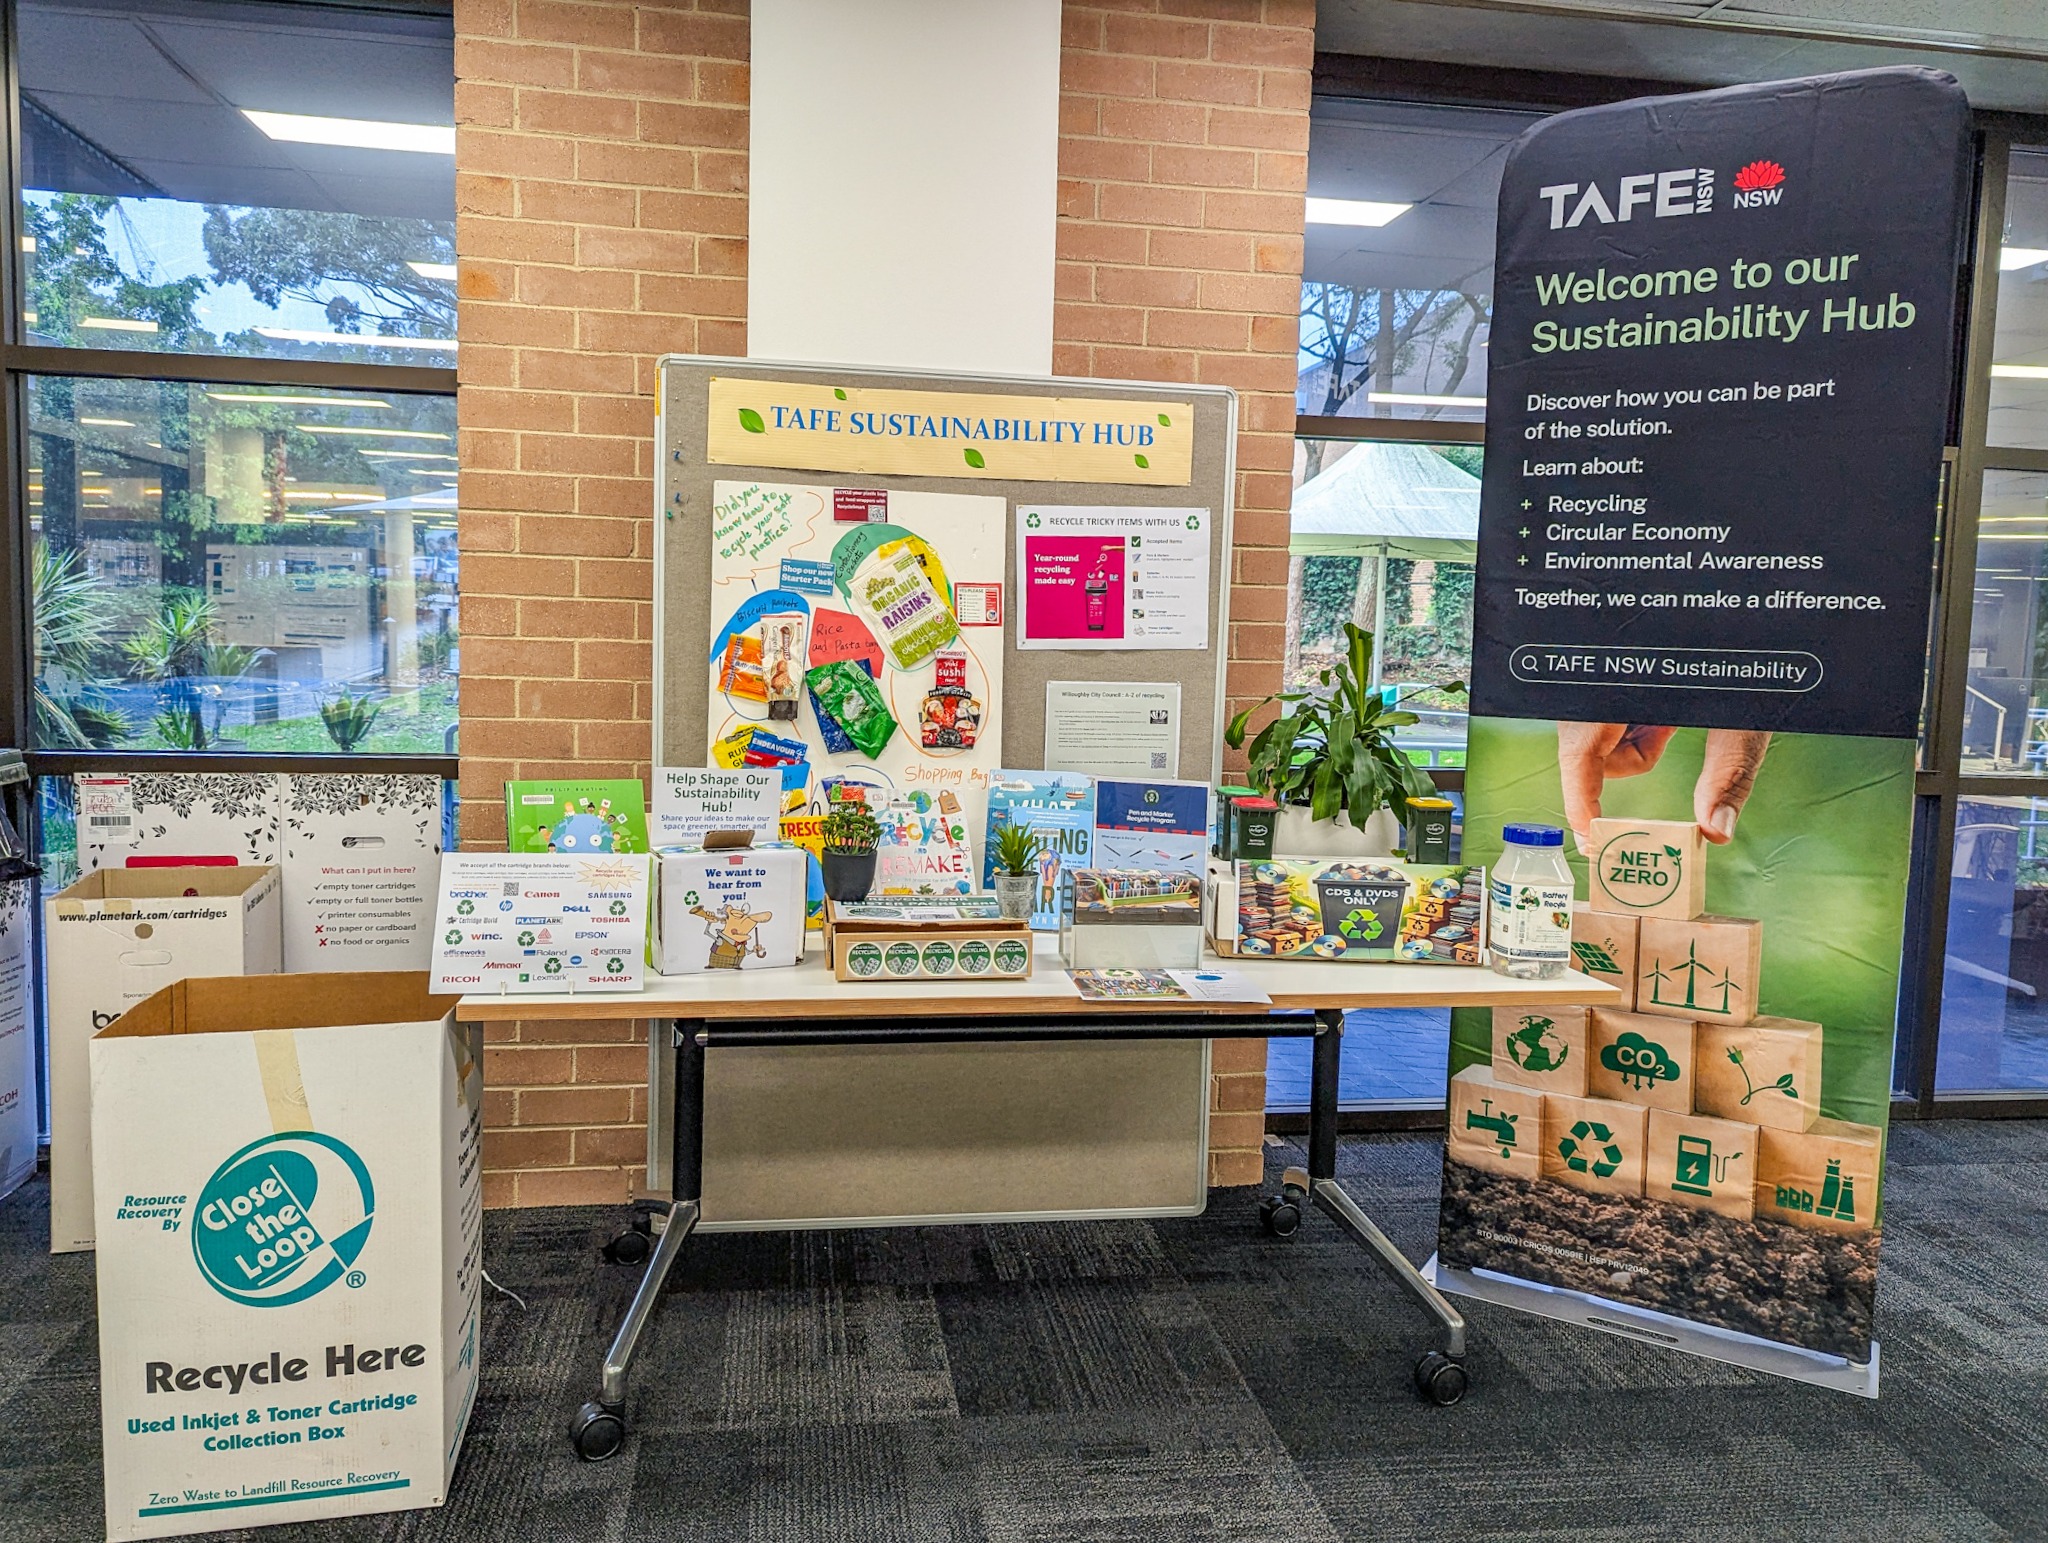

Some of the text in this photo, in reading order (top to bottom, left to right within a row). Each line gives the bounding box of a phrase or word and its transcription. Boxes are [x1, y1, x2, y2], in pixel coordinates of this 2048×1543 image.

[1539, 168, 1715, 230] TAFE NSW
[1733, 188, 1783, 209] NSW
[1535, 253, 1859, 306] Welcome to our
[1531, 293, 1916, 353] Sustainability Hub
[1527, 378, 1836, 412] Discover how you can be part
[770, 405, 1155, 446] TAFE SUSTAINABILITY HUB
[1524, 417, 1673, 440] of the solution.
[1522, 456, 1644, 477] Learn about:
[1548, 494, 1648, 517] Recycling
[1050, 517, 1180, 527] RECYCLE TRICKY ITEMS WITH US
[1546, 522, 1731, 544] Circular Economy
[1034, 553, 1080, 563] Year-round
[1544, 551, 1824, 571] Environmental Awareness
[782, 565, 802, 575] Shop
[1034, 565, 1071, 575] recycling
[781, 573, 833, 586] Starter Pack
[1034, 577, 1076, 587] made easy
[872, 576, 920, 612] ORGANIC
[1514, 588, 1887, 611] Together, we can make a difference.
[882, 592, 932, 630] RAISINS
[816, 623, 844, 635] Rice
[812, 640, 861, 653] and Pasta
[938, 667, 965, 677] sushi
[1544, 654, 1808, 683] TAFE NSW Sustainability
[752, 737, 795, 756] ENDEAVOUR
[666, 773, 770, 786] Help Shape Our
[905, 764, 988, 789] Shopping Bag
[674, 787, 760, 801] Sustainability
[701, 801, 732, 813] Hub!
[661, 814, 683, 822] Share
[704, 814, 724, 822] ideas
[735, 814, 755, 822] make
[663, 823, 686, 831] space
[687, 823, 718, 832] greener,
[720, 823, 750, 831] smarter,
[882, 854, 964, 875] REMAKE
[1620, 850, 1663, 868] NET
[367, 867, 381, 875] put
[393, 866, 416, 874] here?
[705, 868, 766, 877] We want to
[1609, 867, 1669, 888] ZERO
[375, 882, 416, 890] cartridges
[708, 879, 762, 890] hear from
[722, 892, 747, 903] you!
[1325, 888, 1399, 898] CDS & DVDS
[1343, 897, 1378, 906] ONLY
[1544, 901, 1566, 909] Recyle
[59, 908, 228, 923] www.planetark.com/cartridges
[327, 910, 411, 920] printer consumables
[532, 973, 567, 981] Lexmark
[124, 1195, 187, 1207] Resource
[202, 1174, 283, 1231] Close
[117, 1208, 182, 1220] Recovery
[162, 1219, 181, 1232] By
[245, 1203, 302, 1245] the
[235, 1224, 316, 1280] Loop
[1476, 1228, 1650, 1275] RTO 90003 CRICOS 00591E HEP PRV12049
[145, 1343, 426, 1395] Recycle Here
[128, 1392, 418, 1435] Used Inkjet & Toner Cartridge
[203, 1425, 346, 1452] Collection Box
[149, 1470, 401, 1506] Zero Waste to Landfill Resource Recovery
